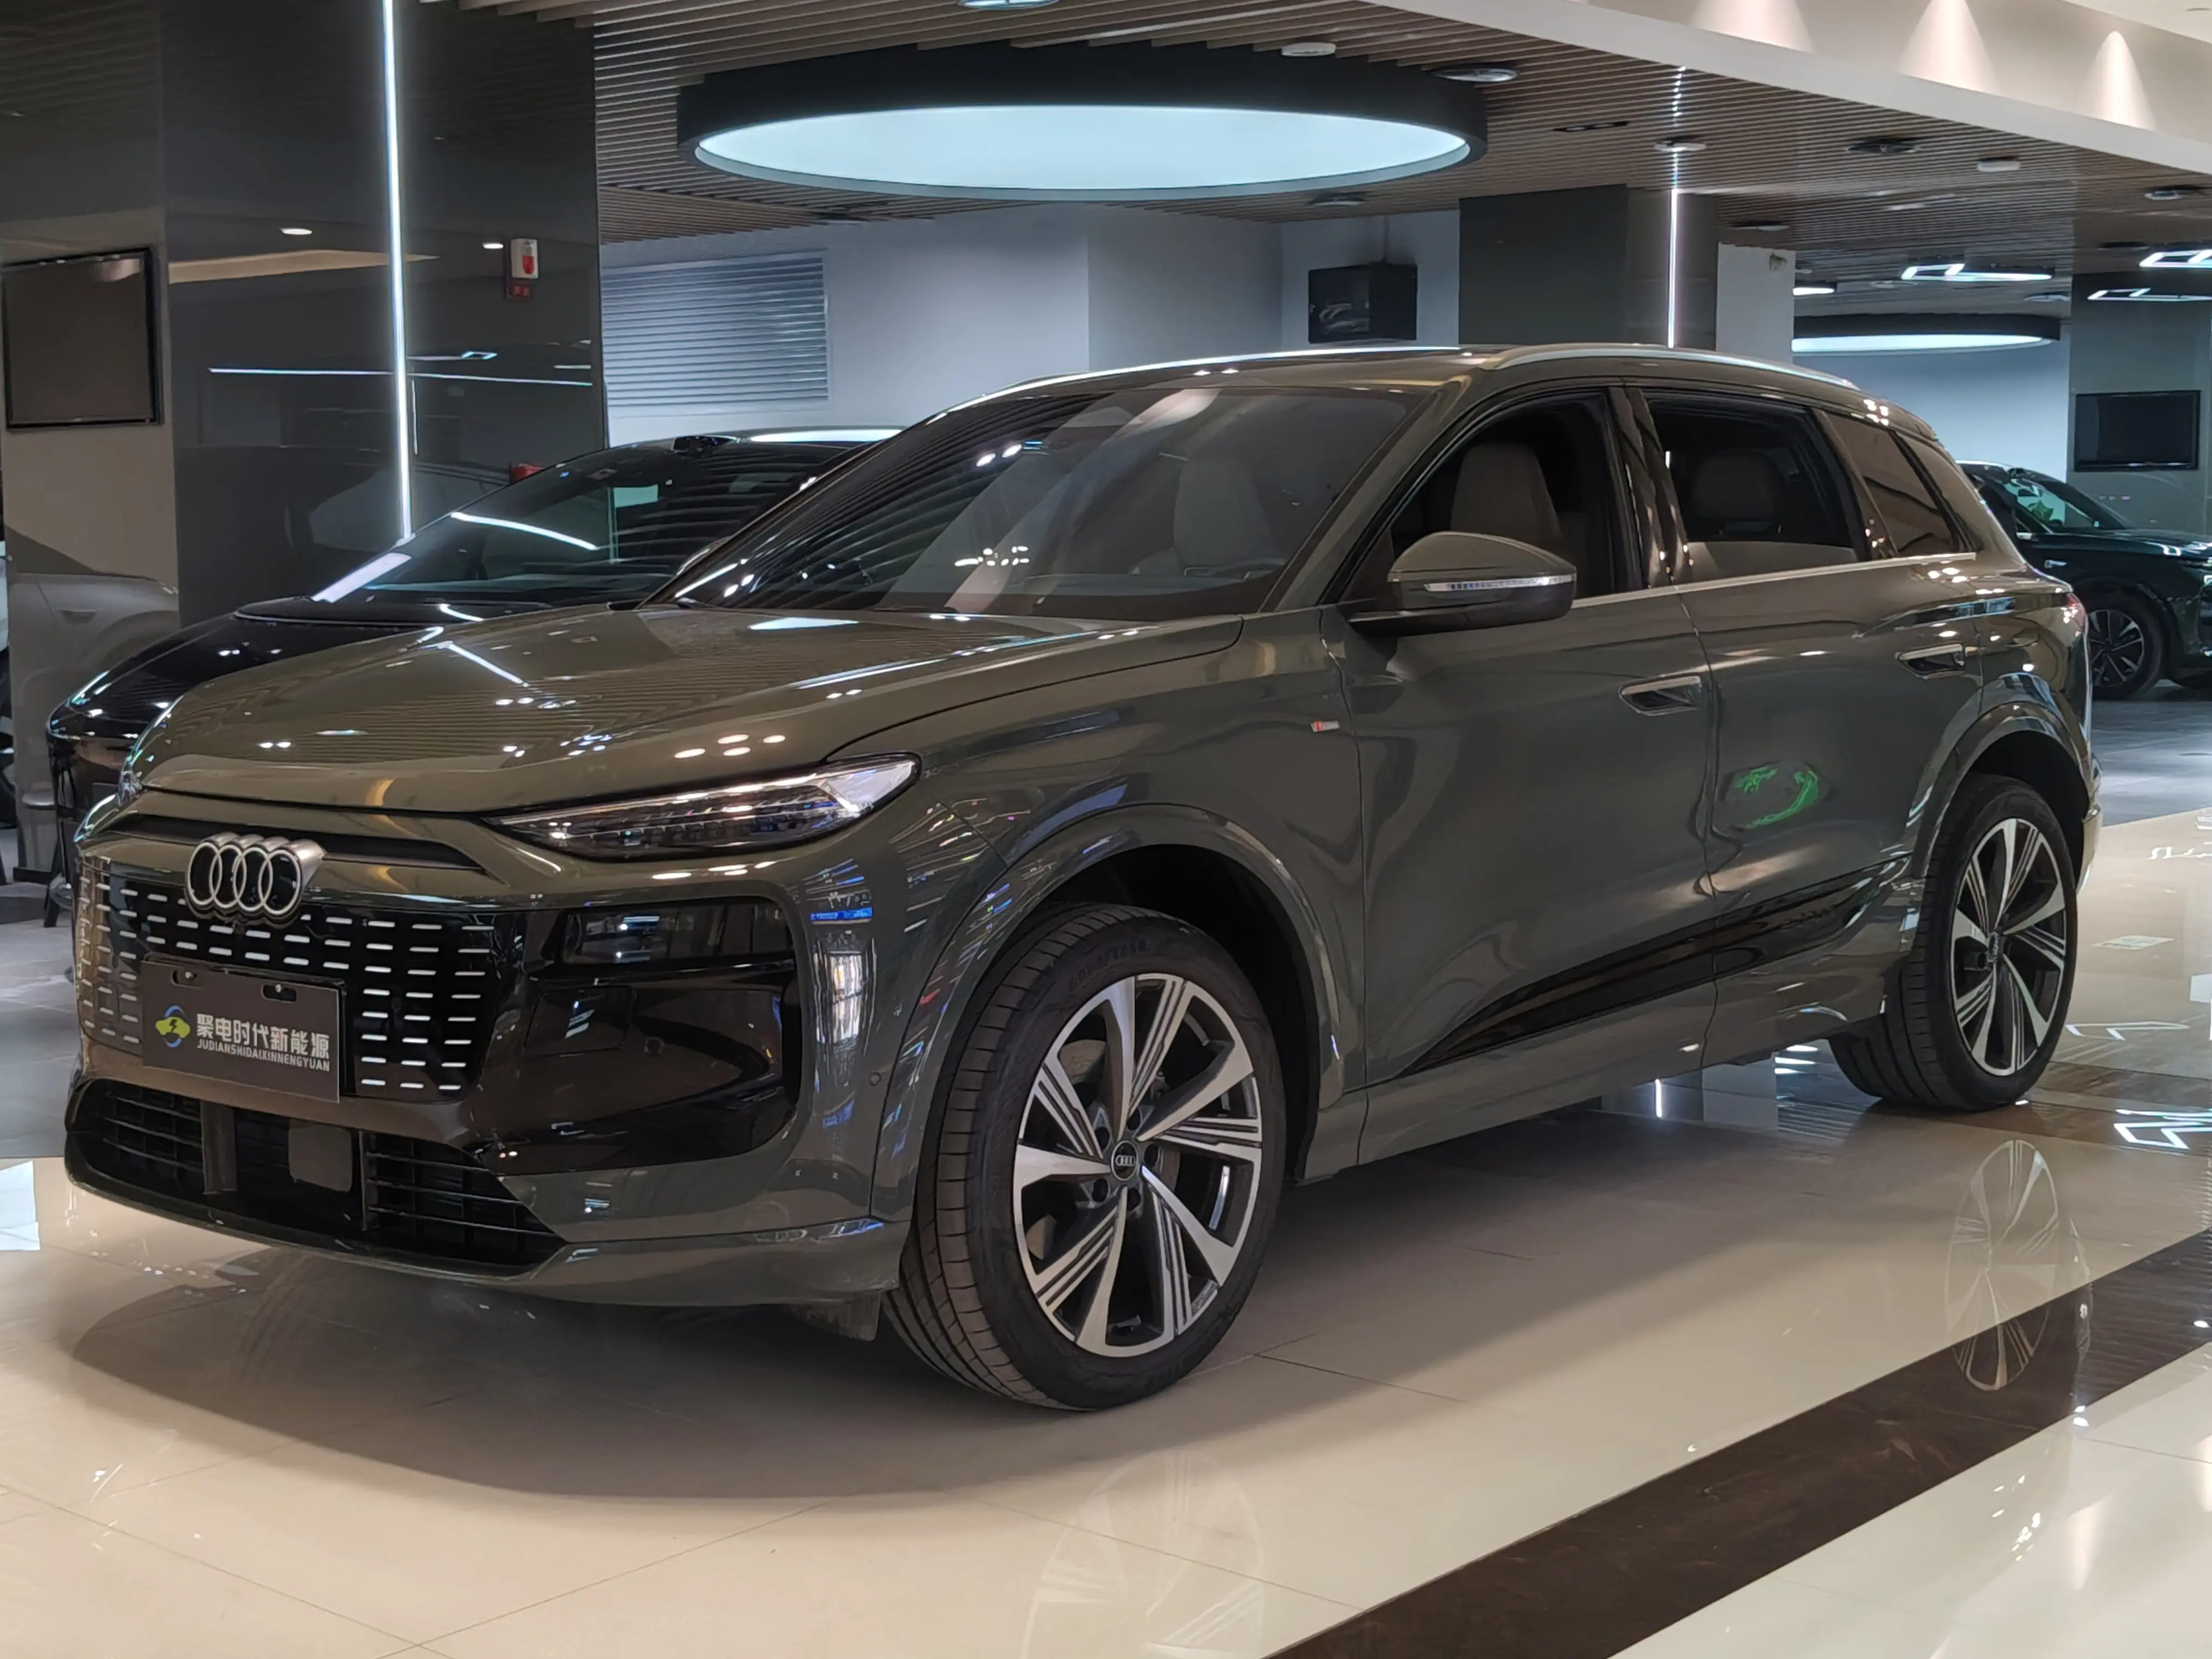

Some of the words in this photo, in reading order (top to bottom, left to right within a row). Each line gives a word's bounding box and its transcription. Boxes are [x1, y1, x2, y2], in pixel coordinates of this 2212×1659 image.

[197, 1014, 329, 1058] 聚电时代新能源
[197, 1039, 329, 1071] JUDIANSHIDAIXINNENGYUAN
